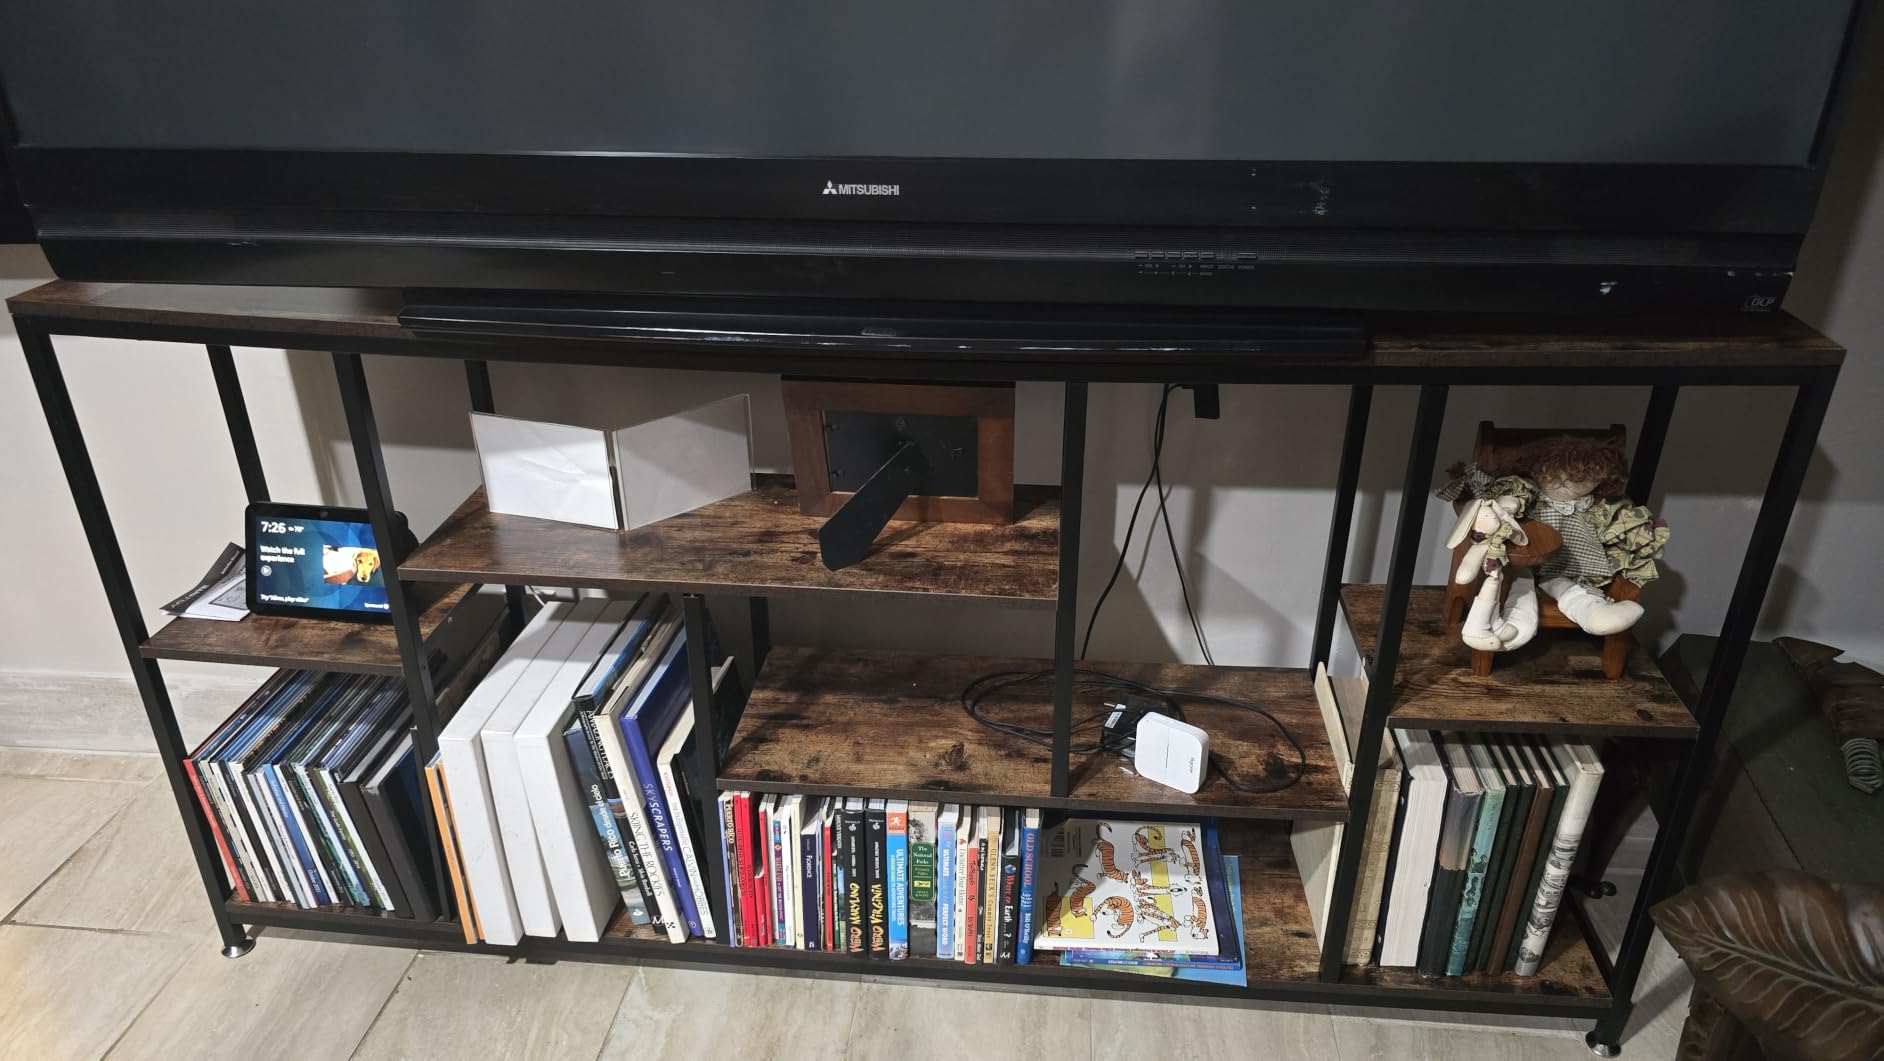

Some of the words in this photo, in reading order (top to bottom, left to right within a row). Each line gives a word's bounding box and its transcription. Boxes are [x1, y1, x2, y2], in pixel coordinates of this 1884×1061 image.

[838, 183, 900, 196] MITSUBISHI
[260, 521, 286, 534] 7:26
[260, 545, 281, 554] Watch
[281, 546, 293, 555] the
[293, 547, 306, 556] full
[260, 555, 295, 563] experience
[589, 783, 602, 802] cielo
[598, 806, 611, 829] desde
[642, 781, 673, 853] SKYSCRAPERS
[725, 803, 733, 827] PUERTO
[604, 828, 619, 849] Rico
[727, 828, 735, 843] RICO
[1025, 832, 1034, 851] OLD
[611, 847, 629, 877] Puerto
[638, 842, 652, 859] THE
[942, 848, 950, 876] ULTIMATE
[958, 848, 966, 875] Unclutter
[989, 848, 997, 871] GLENN
[805, 855, 813, 878] FLORENCE
[895, 849, 904, 881] ULTIMATE
[1023, 852, 1034, 887] SCHOOL
[644, 859, 665, 897] ROCKIES
[681, 845, 697, 877] CALVIN
[692, 886, 708, 916] HOBBES
[987, 873, 996, 898] BECK'S
[1005, 874, 1014, 894] Where
[848, 882, 860, 924] MARYLAND
[896, 882, 905, 925] ADVENTURES
[941, 903, 949, 925] PERFECT
[1022, 923, 1030, 944] O'Reilly
